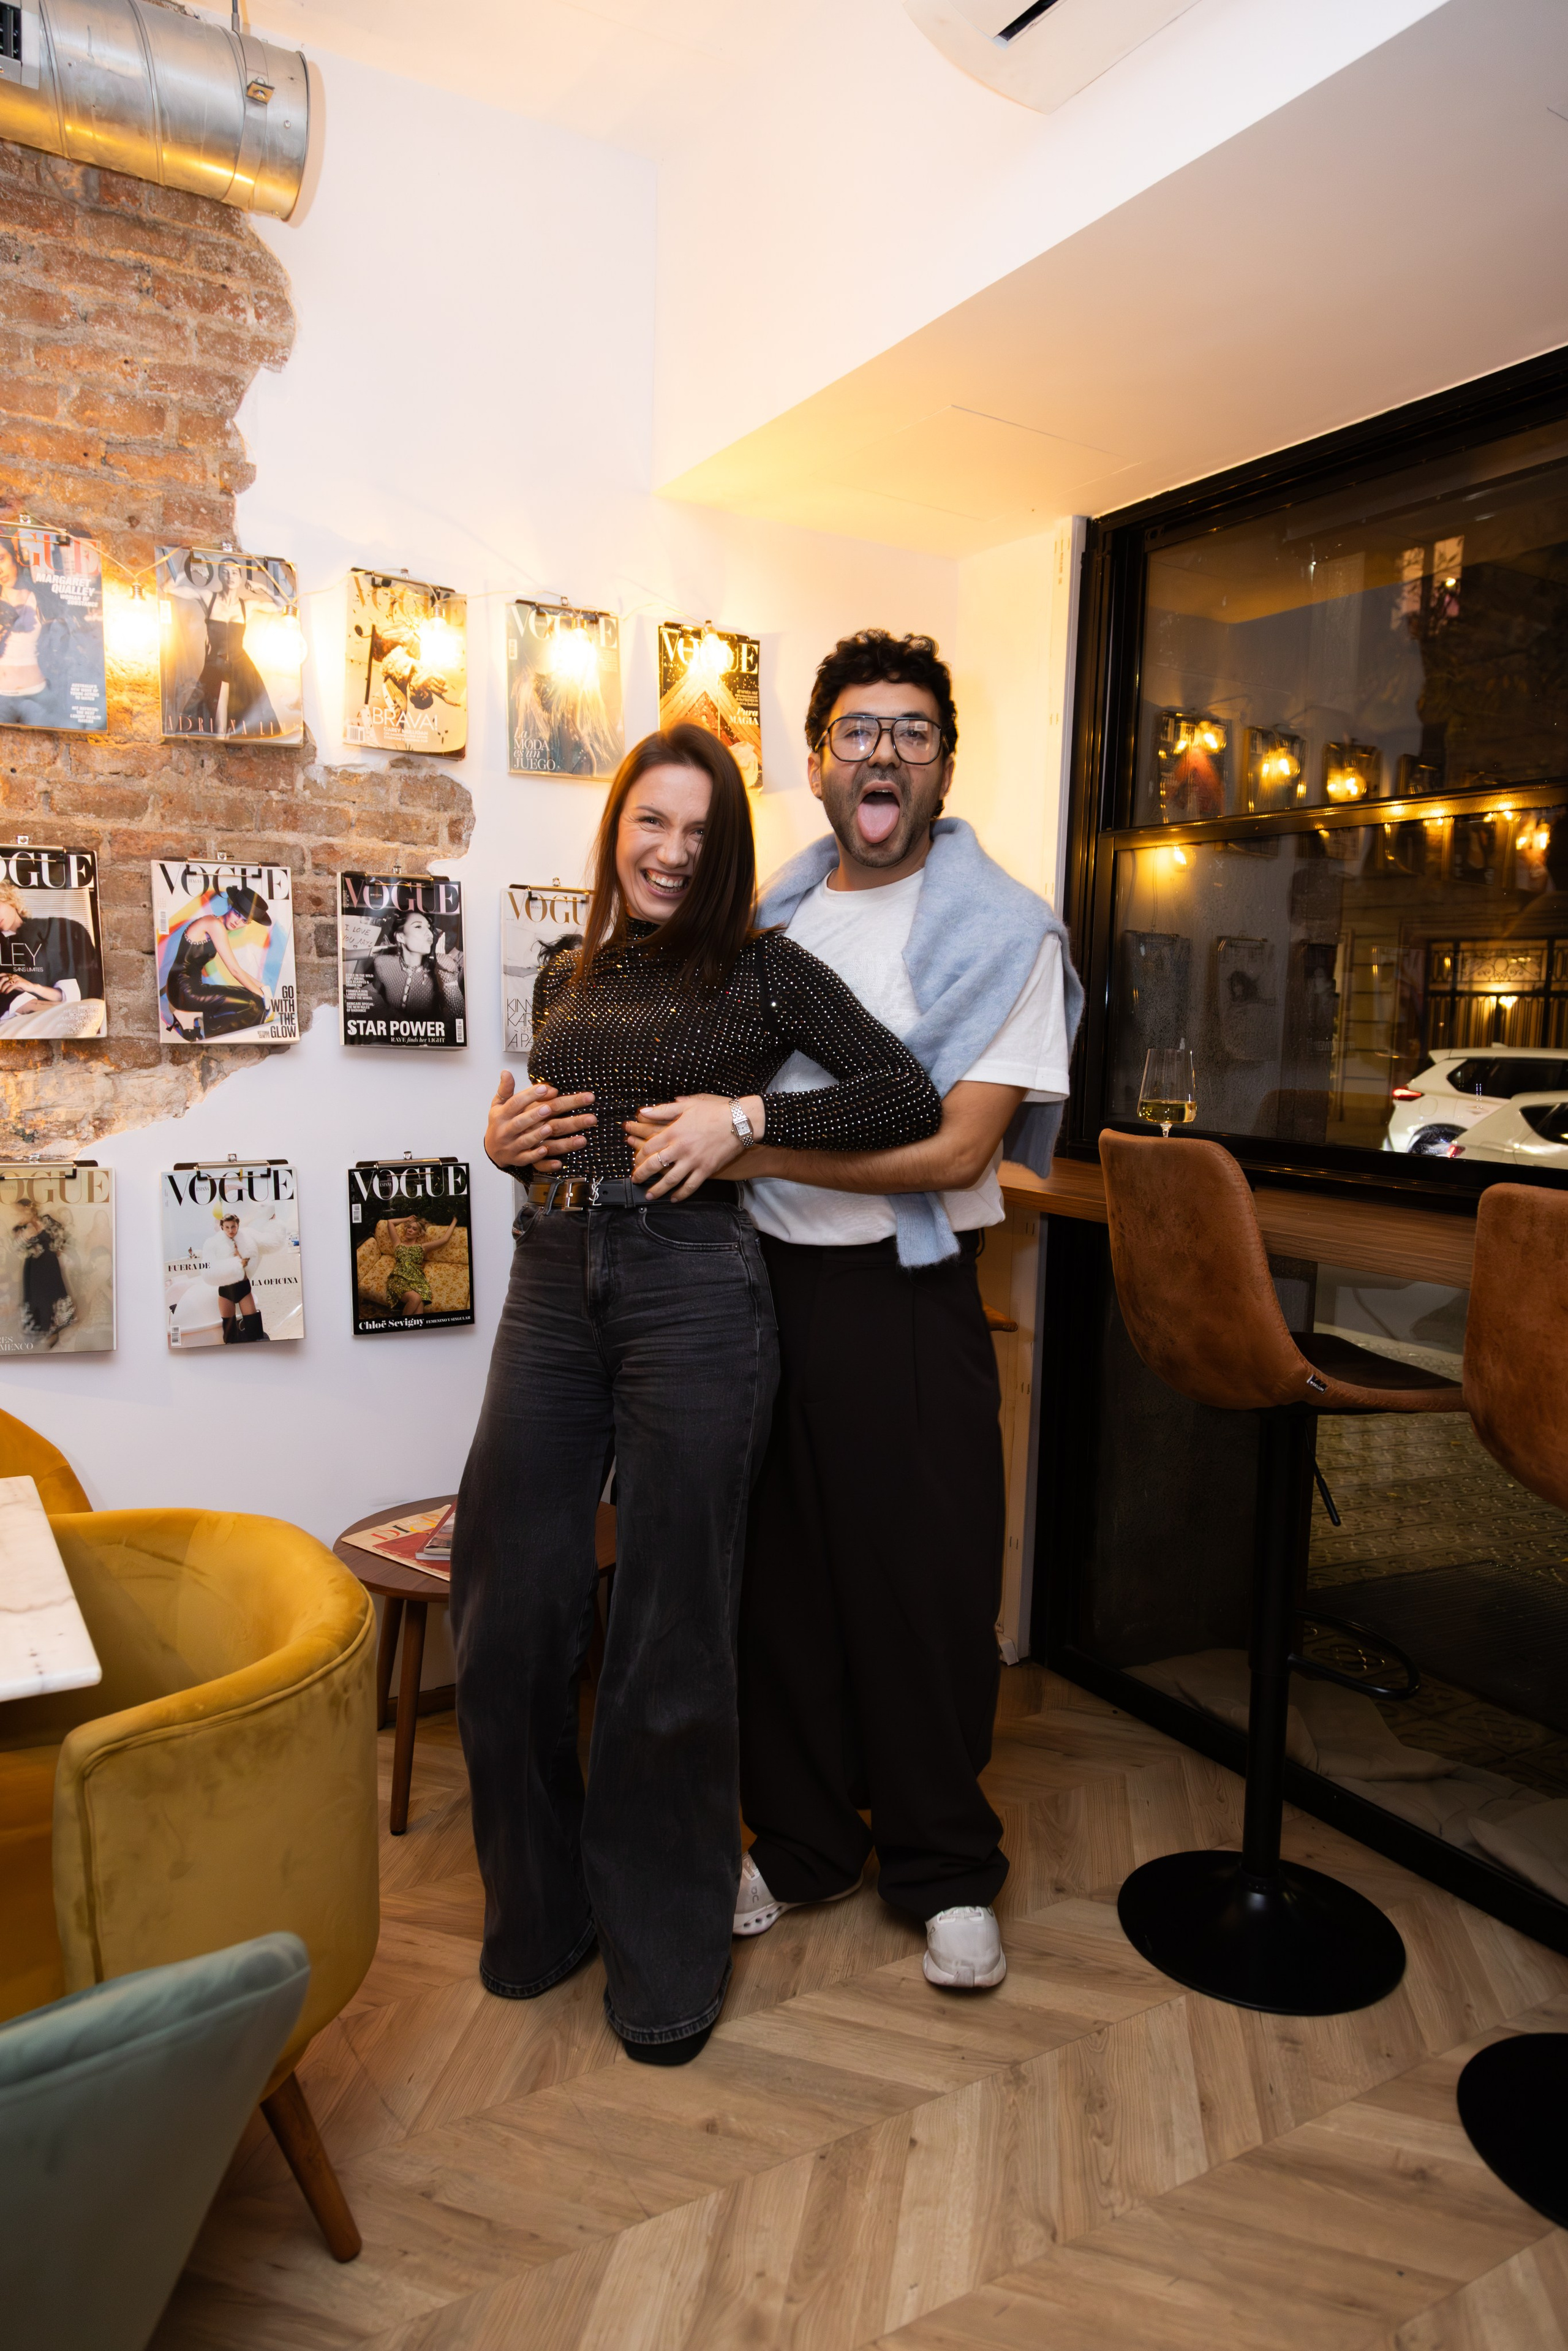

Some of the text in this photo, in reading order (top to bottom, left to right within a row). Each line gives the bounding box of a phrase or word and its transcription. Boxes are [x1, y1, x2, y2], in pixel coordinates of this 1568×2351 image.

[0, 528, 100, 576] GUE
[157, 545, 296, 598] VOE
[36, 572, 91, 587] MARGARET
[51, 583, 96, 597] QUALLEY
[67, 599, 99, 608] SUBSTANCE
[353, 575, 465, 627] VOGE
[510, 604, 617, 649] VOE
[660, 630, 759, 674] VOUE
[372, 707, 438, 731] BRAVA!
[737, 708, 759, 717] Pura
[729, 715, 759, 726] MAGIA
[260, 720, 302, 737] LIM
[514, 727, 527, 739] La
[514, 738, 550, 751] MODA
[526, 750, 540, 759] un
[514, 757, 556, 771] JUEGO
[343, 877, 460, 914] VOGUE
[353, 926, 371, 936] LOVE
[343, 934, 355, 943] YOU
[282, 986, 294, 999] GO
[271, 999, 295, 1013] WITH
[278, 1013, 296, 1025] THE
[270, 1025, 296, 1038] GLOW
[347, 1019, 445, 1036] STAR POWER
[507, 1030, 518, 1047] À
[0, 1170, 110, 1206] OGUE
[163, 1169, 294, 1207] VOGUE
[351, 1165, 467, 1202] VOGUE
[168, 1263, 197, 1272] FUERA
[263, 1277, 298, 1286] OFICINA
[358, 1320, 387, 1330] Chloë
[388, 1318, 424, 1328] Sevigny
